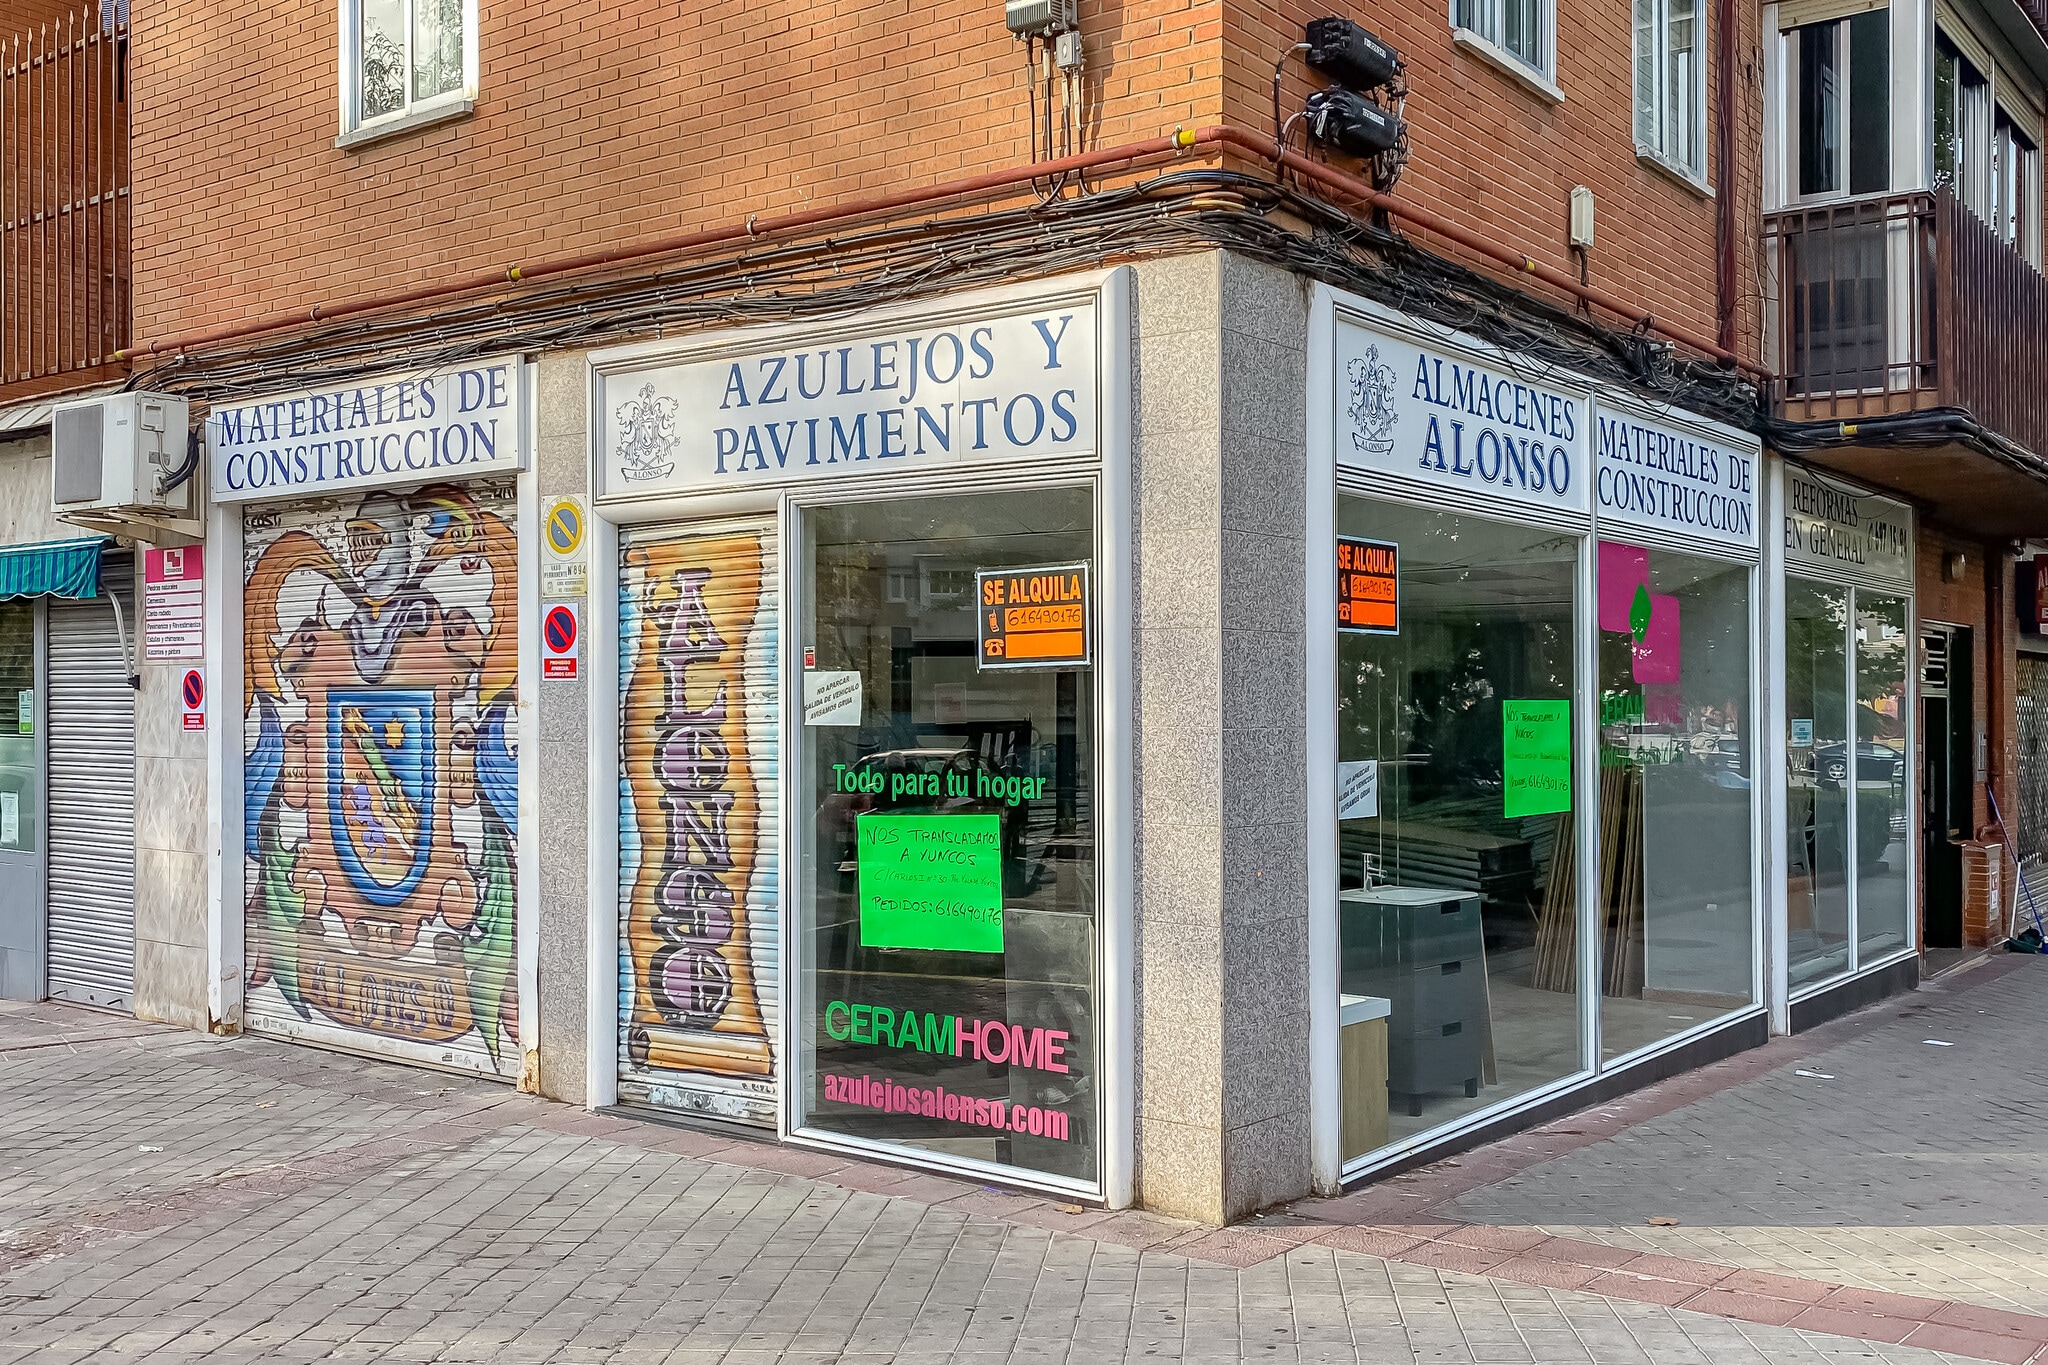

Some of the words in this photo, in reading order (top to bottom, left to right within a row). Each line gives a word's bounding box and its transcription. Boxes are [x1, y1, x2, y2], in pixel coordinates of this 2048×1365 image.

[719, 326, 994, 410] AZULEJOS
[1031, 314, 1074, 370] Y
[219, 377, 437, 447] MATERIALES
[458, 365, 509, 413] DE
[1411, 353, 1575, 442] ALMACENES
[225, 418, 499, 491] CONSTRUCCION
[713, 389, 1077, 475] PAVIMENTOS
[1361, 440, 1385, 450] ALONSO
[1419, 413, 1571, 498] ALONSO
[1598, 416, 1720, 487] MATERIALES
[1728, 453, 1752, 494] DE
[632, 469, 662, 479] ALONSO
[1598, 466, 1752, 538] CONSTRUCCION
[1792, 478, 1858, 528] REFORMAS
[1338, 542, 1351, 571] SE
[1353, 545, 1395, 575] ALQUILA
[1785, 516, 1803, 550] EN
[1809, 522, 1866, 565] GENERAL
[983, 579, 1005, 606] SE
[1009, 574, 1082, 605] ALQUILA
[1008, 607, 1081, 627] 616490176
[816, 687, 825, 696] NO
[826, 675, 850, 692] APARCAR
[824, 694, 832, 703] DE
[810, 703, 837, 720] AVISAMOS
[832, 763, 885, 793] Todo
[891, 772, 940, 802] para
[947, 769, 969, 798] tu
[977, 768, 1046, 807] hogar
[866, 826, 900, 846] NOS
[900, 847, 910, 862] A
[920, 849, 976, 866] YUNCOS
[825, 1000, 1069, 1074] CERAMHOME
[824, 1074, 1069, 1141] azulejosalonso.com
